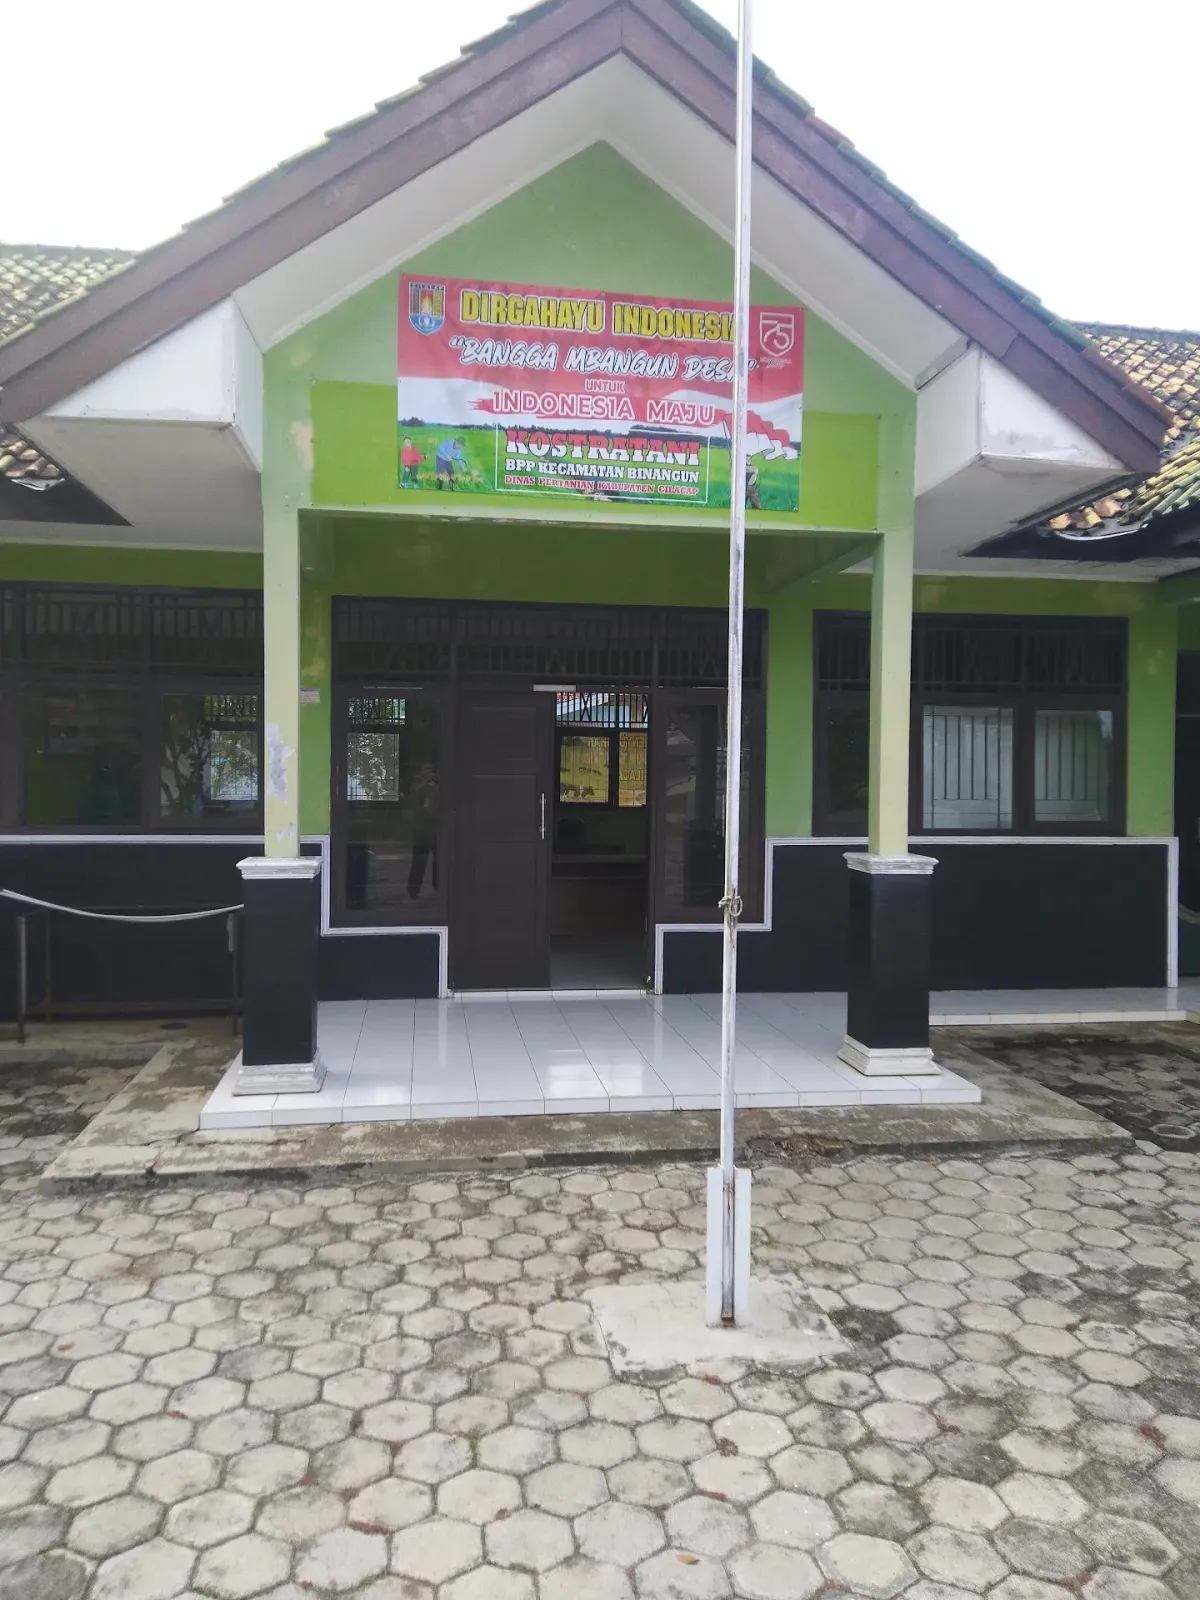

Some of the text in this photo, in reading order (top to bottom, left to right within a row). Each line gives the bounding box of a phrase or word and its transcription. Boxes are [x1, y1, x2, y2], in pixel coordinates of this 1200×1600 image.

[460, 289, 605, 333] DIRGAHAYU
[450, 335, 558, 370] "BANGGA
[564, 346, 678, 379] MBANGUN
[585, 379, 625, 394] UNTUK
[493, 389, 716, 426] INDONESIA MAJU
[505, 428, 700, 466] KOSTRATANI
[505, 458, 700, 483] BPP KECAMATAN BINANGUN
[505, 475, 699, 495] DINAS PERTANIAN KABUPATEN CILACAP
